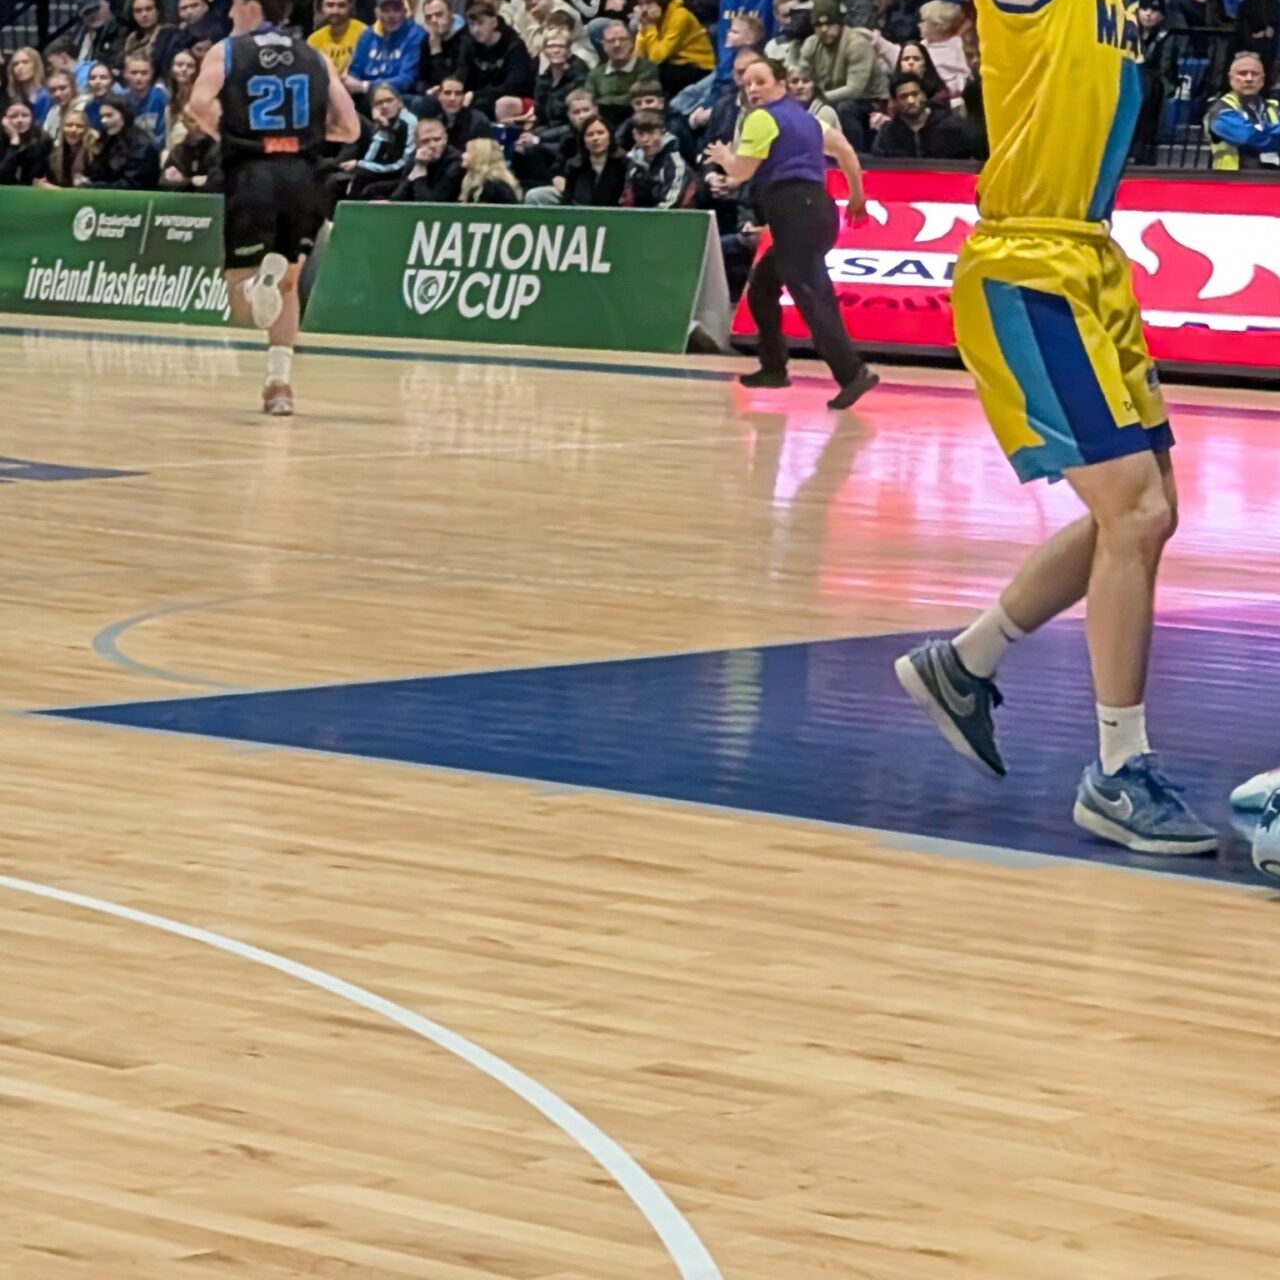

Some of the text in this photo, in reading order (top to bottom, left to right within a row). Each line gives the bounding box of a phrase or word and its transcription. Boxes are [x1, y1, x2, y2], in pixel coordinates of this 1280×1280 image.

[247, 73, 309, 131] 21
[407, 220, 611, 273] NATIONAL
[458, 271, 541, 320] CUP
